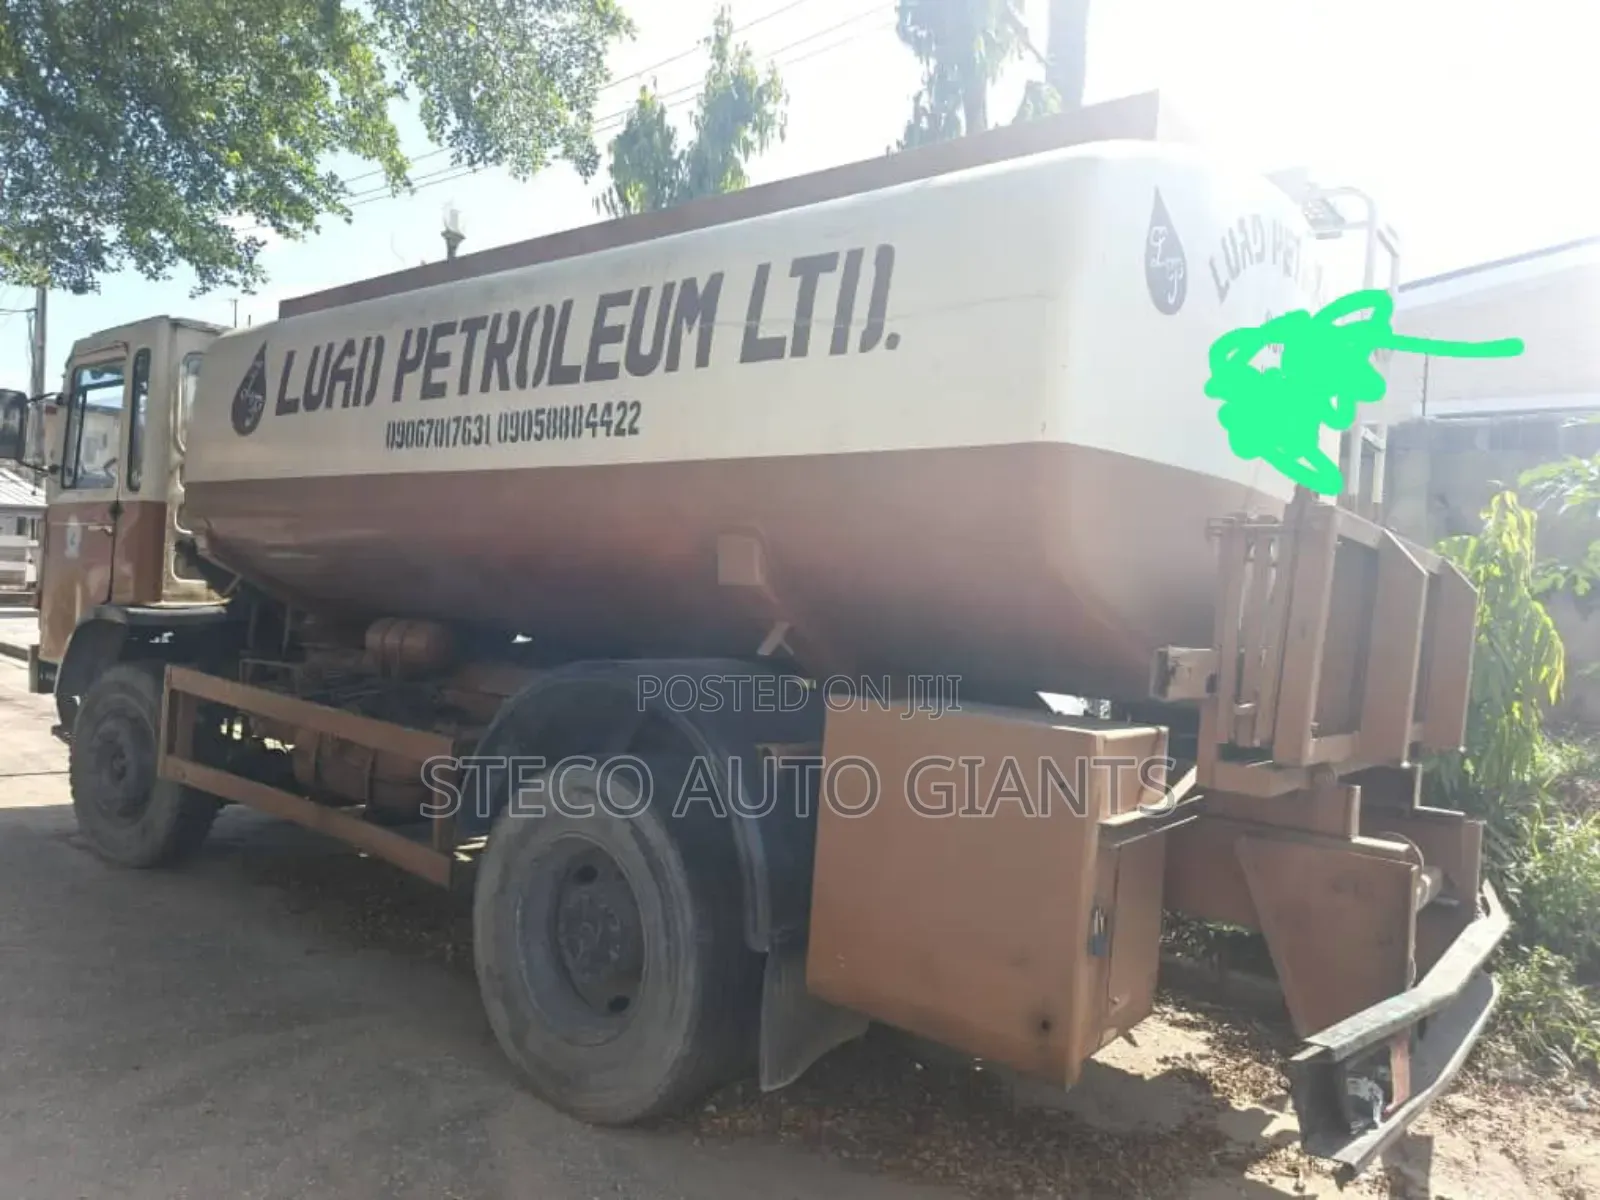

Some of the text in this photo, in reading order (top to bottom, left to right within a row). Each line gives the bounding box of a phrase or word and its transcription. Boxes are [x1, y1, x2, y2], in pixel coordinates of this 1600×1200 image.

[275, 335, 384, 416] LUAD
[393, 271, 725, 403] PETROLEUM
[739, 244, 901, 364] LTD.
